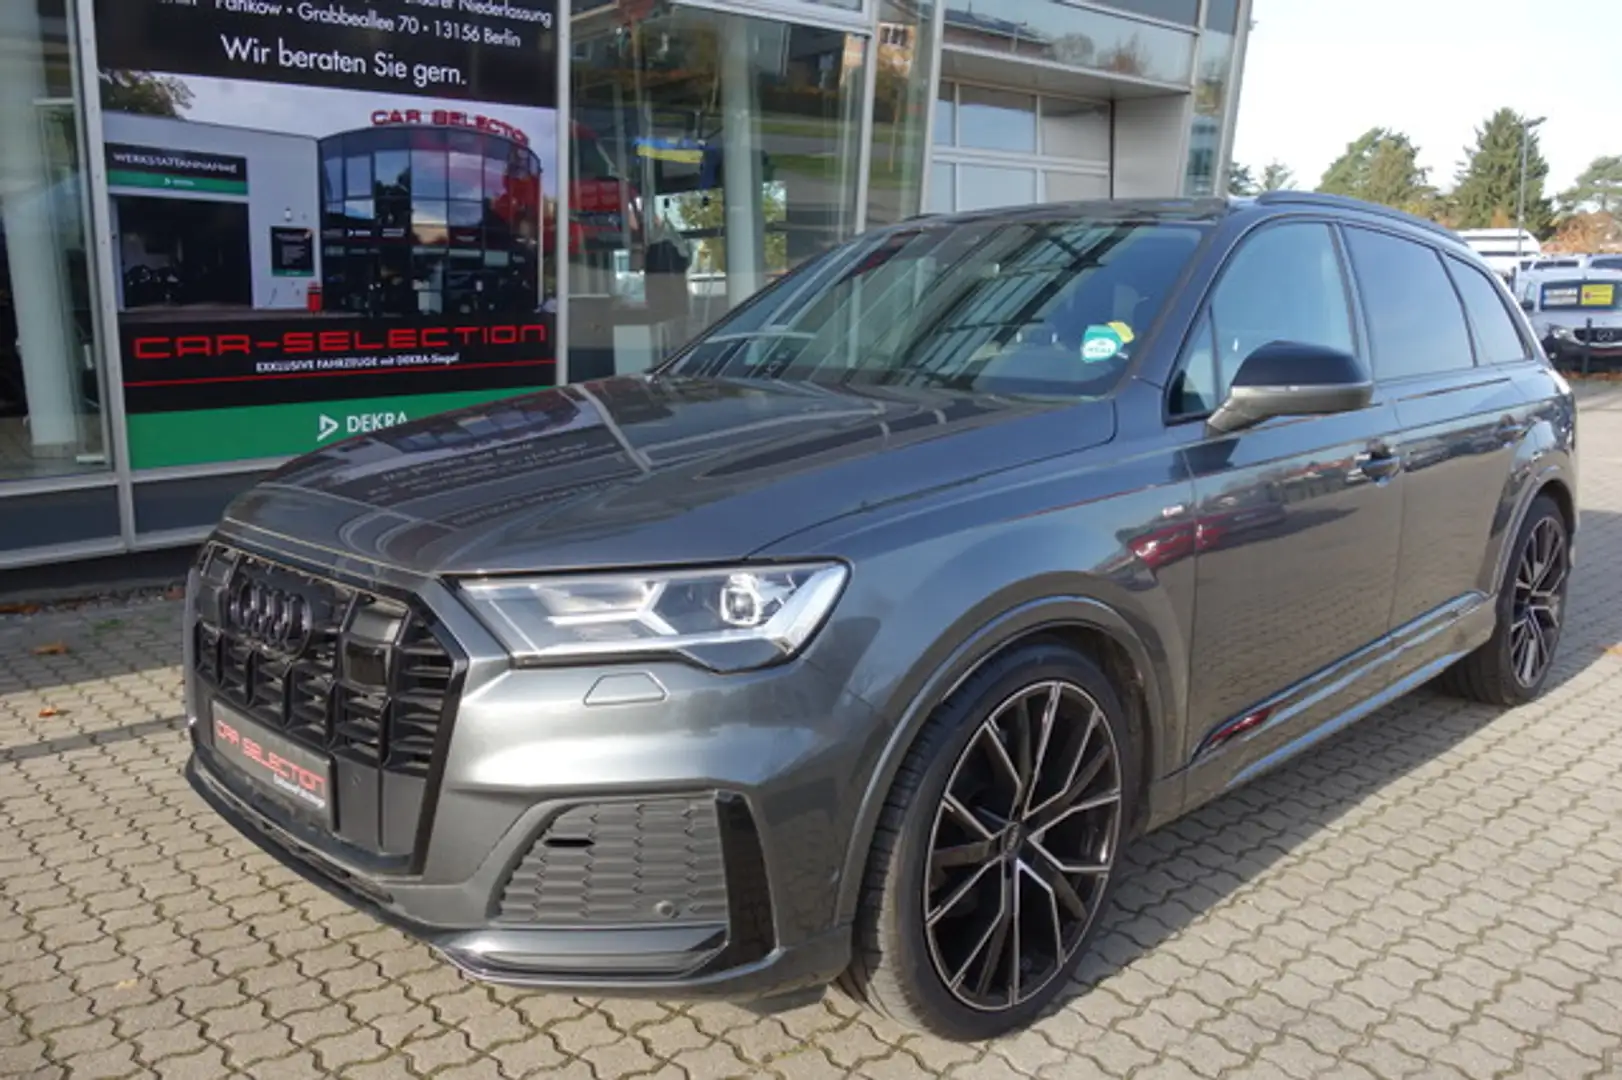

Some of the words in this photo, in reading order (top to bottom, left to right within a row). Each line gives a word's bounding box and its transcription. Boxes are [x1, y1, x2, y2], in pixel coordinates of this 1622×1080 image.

[298, 3, 394, 31] Grabbeallee
[398, 16, 420, 34] 70
[433, 20, 480, 42] 13156
[484, 27, 521, 47] Berlin
[220, 33, 271, 64] Wir
[278, 37, 367, 75] beraten
[374, 50, 407, 78] Sie
[413, 62, 467, 88] gern.
[371, 109, 421, 126] CAR
[134, 324, 546, 360] CAR-SELECTION
[256, 359, 315, 373] EXKLUSIVE
[316, 357, 378, 369] FAHRZEUGE
[346, 410, 408, 433] DEKRA
[216, 719, 239, 746] CAR
